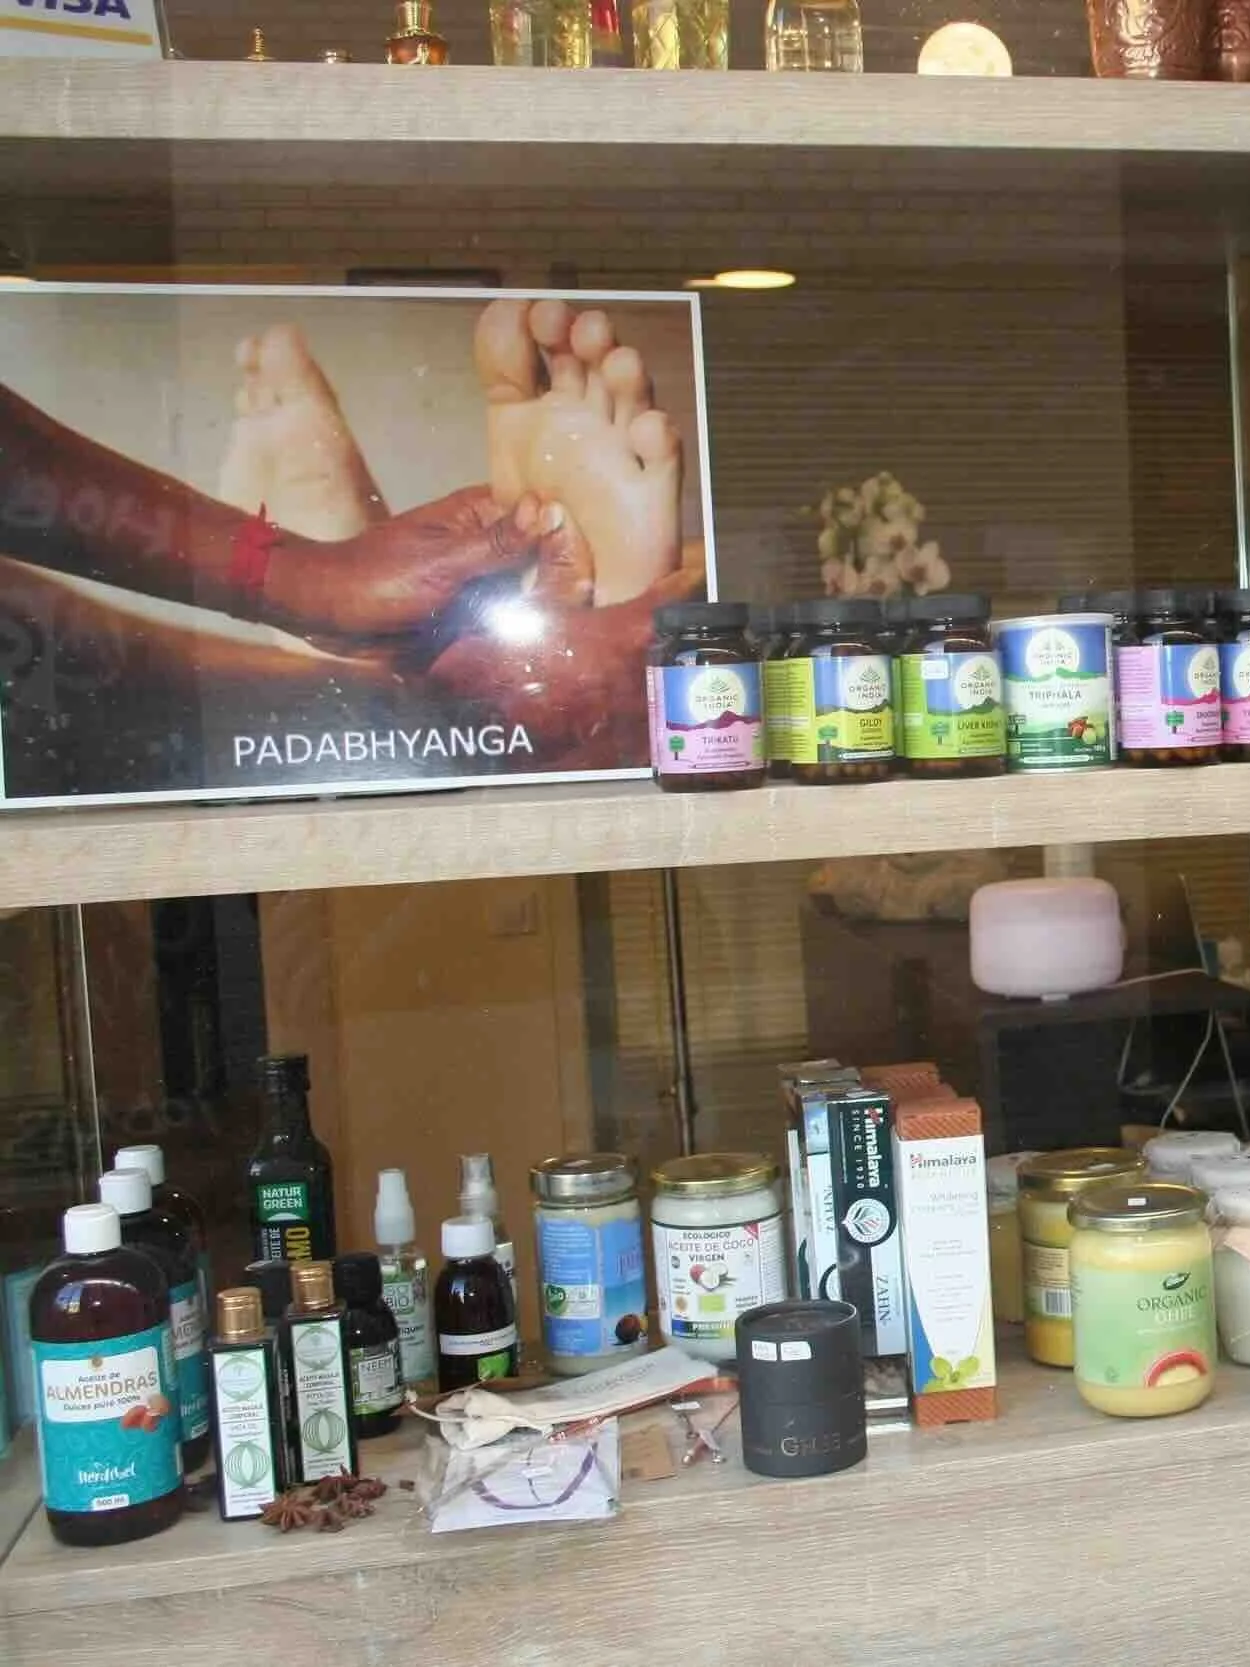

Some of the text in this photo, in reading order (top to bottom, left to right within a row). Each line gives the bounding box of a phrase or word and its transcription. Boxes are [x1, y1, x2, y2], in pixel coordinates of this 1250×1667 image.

[1029, 689, 1082, 701] TRIPHALA
[233, 724, 533, 767] PADABHYANGA
[262, 1186, 302, 1199] NATUR
[262, 1198, 304, 1210] GREEN
[1136, 1284, 1208, 1312] ORGANIC
[46, 1370, 158, 1402] ALMENDRAS
